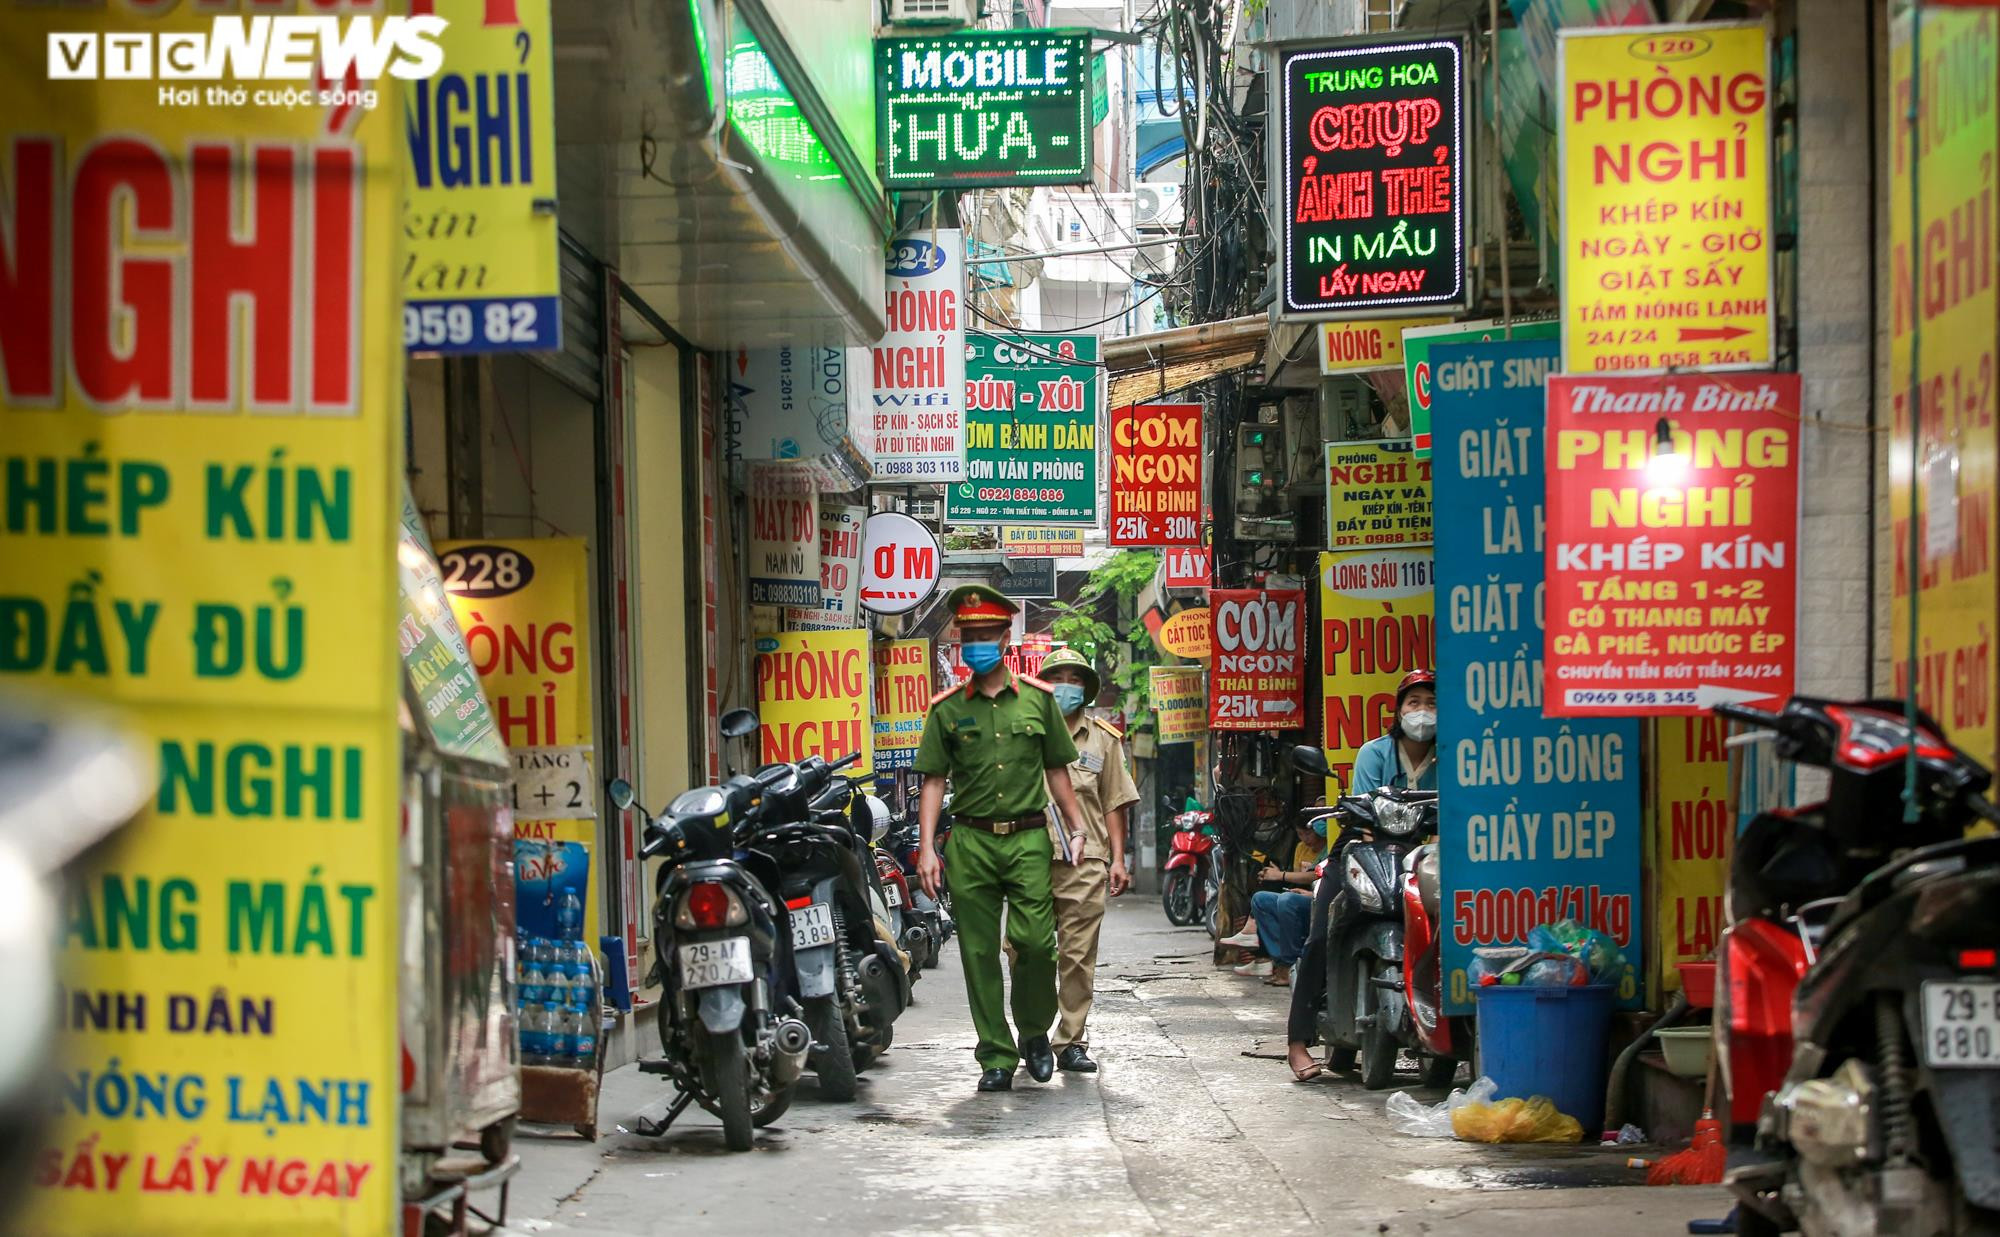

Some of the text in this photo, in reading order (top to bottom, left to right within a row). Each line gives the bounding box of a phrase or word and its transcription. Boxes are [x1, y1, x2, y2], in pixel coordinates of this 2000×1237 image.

[1647, 40, 1695, 54] 120
[902, 48, 1067, 89] MOBILE
[1304, 62, 1439, 93] TRUNG HOA
[1574, 65, 1767, 124] PHÒNG
[1309, 98, 1441, 157] CHỤP
[1593, 121, 1748, 185] NGHỈ
[1296, 146, 1451, 222] ẢNH THẺ
[1600, 195, 1743, 225] KHÉP KÍN
[1308, 235, 1341, 263] IN
[1580, 227, 1762, 259] NGÀY GIỜ
[1320, 263, 1426, 297] LẤY NGAY
[1600, 257, 1744, 296] GIẶT SẤY
[484, 302, 538, 343] 82
[1636, 298, 1767, 320] NÓNG LẠNH
[1328, 324, 1382, 362] NÓNG
[1587, 329, 1657, 345] 24/24
[874, 334, 944, 389] NGHỈ
[1057, 340, 1076, 366] 8
[1595, 355, 1650, 371] 0969
[1437, 355, 1494, 397] GIẶT
[873, 393, 950, 406] Wifi
[965, 374, 1085, 412] BÚN XÔI
[1570, 384, 1683, 414] Thanh
[891, 411, 908, 430] KÍN
[918, 413, 943, 432] SẠCH
[1054, 420, 1094, 450] DÂN
[1114, 413, 1198, 447] CƠM
[906, 433, 928, 455] TIỆN
[931, 436, 954, 452] NGHI
[1338, 452, 1377, 464] PHÒNG
[1460, 418, 1531, 488] GIẶT
[886, 461, 959, 474] 0988 303 118
[998, 457, 1084, 481] VĂN PHÒNG
[1115, 454, 1197, 484] NGON
[1330, 457, 1408, 486] NGHỈ
[205, 447, 350, 541] KÍN
[979, 488, 1064, 501] 0924 884 886
[1115, 486, 1196, 512] THÁI BÌNH
[1344, 486, 1426, 501] NGÀY VÀ
[1363, 501, 1402, 515] KHÉP KÍN
[1590, 473, 1755, 528] NGHỈ
[754, 499, 787, 541] MAY
[990, 507, 998, 515] 22
[1003, 507, 1015, 515] TÔN
[1372, 515, 1431, 530] ĐỦ TIỆN
[1483, 495, 1523, 555] LÀ
[1058, 530, 1076, 540] NGHI
[1116, 516, 1196, 539] 25k 30k
[1336, 533, 1404, 545] ĐT: 0988
[766, 552, 787, 574] NAM
[1169, 548, 1206, 578] LẤY
[1556, 534, 1785, 571] KHÉP KÍN
[443, 552, 521, 590] 228
[1332, 558, 1426, 590] LONG SÁU 116
[768, 584, 818, 604] 0988303118
[1450, 573, 1523, 643] GIẶT
[191, 576, 305, 679] ĐỦ
[1216, 592, 1296, 652] CƠM
[1568, 603, 1771, 628] CÓ THANG MÁY
[1167, 622, 1204, 644] CẮT TÓC
[1554, 631, 1591, 655] CÀ
[1667, 632, 1743, 655] NƯỚC
[1750, 631, 1785, 653] ÉP
[760, 640, 862, 702] PHÒNG
[1219, 655, 1294, 673] NGON
[1664, 663, 1694, 678] RÚT
[1733, 664, 1782, 679] 24/24
[895, 674, 928, 718] TRỌ
[1218, 676, 1296, 691] THÁI BÌNH
[1573, 692, 1697, 704] 0969 958 345
[1218, 695, 1259, 718] 25k
[1214, 719, 1232, 728] CÓ
[1270, 718, 1299, 728] HÒA
[895, 750, 911, 758] 219
[895, 760, 912, 768] 345
[1457, 721, 1624, 786] GẤU BÔNG
[158, 739, 363, 820] NGHI
[1467, 797, 1615, 863] GIẦY DÉP
[227, 865, 375, 957] MÁT
[167, 986, 274, 1035] DÂN
[226, 1076, 371, 1137] LẠNH
[140, 1136, 229, 1193] LẤY
[240, 1158, 371, 1198] NGAY
